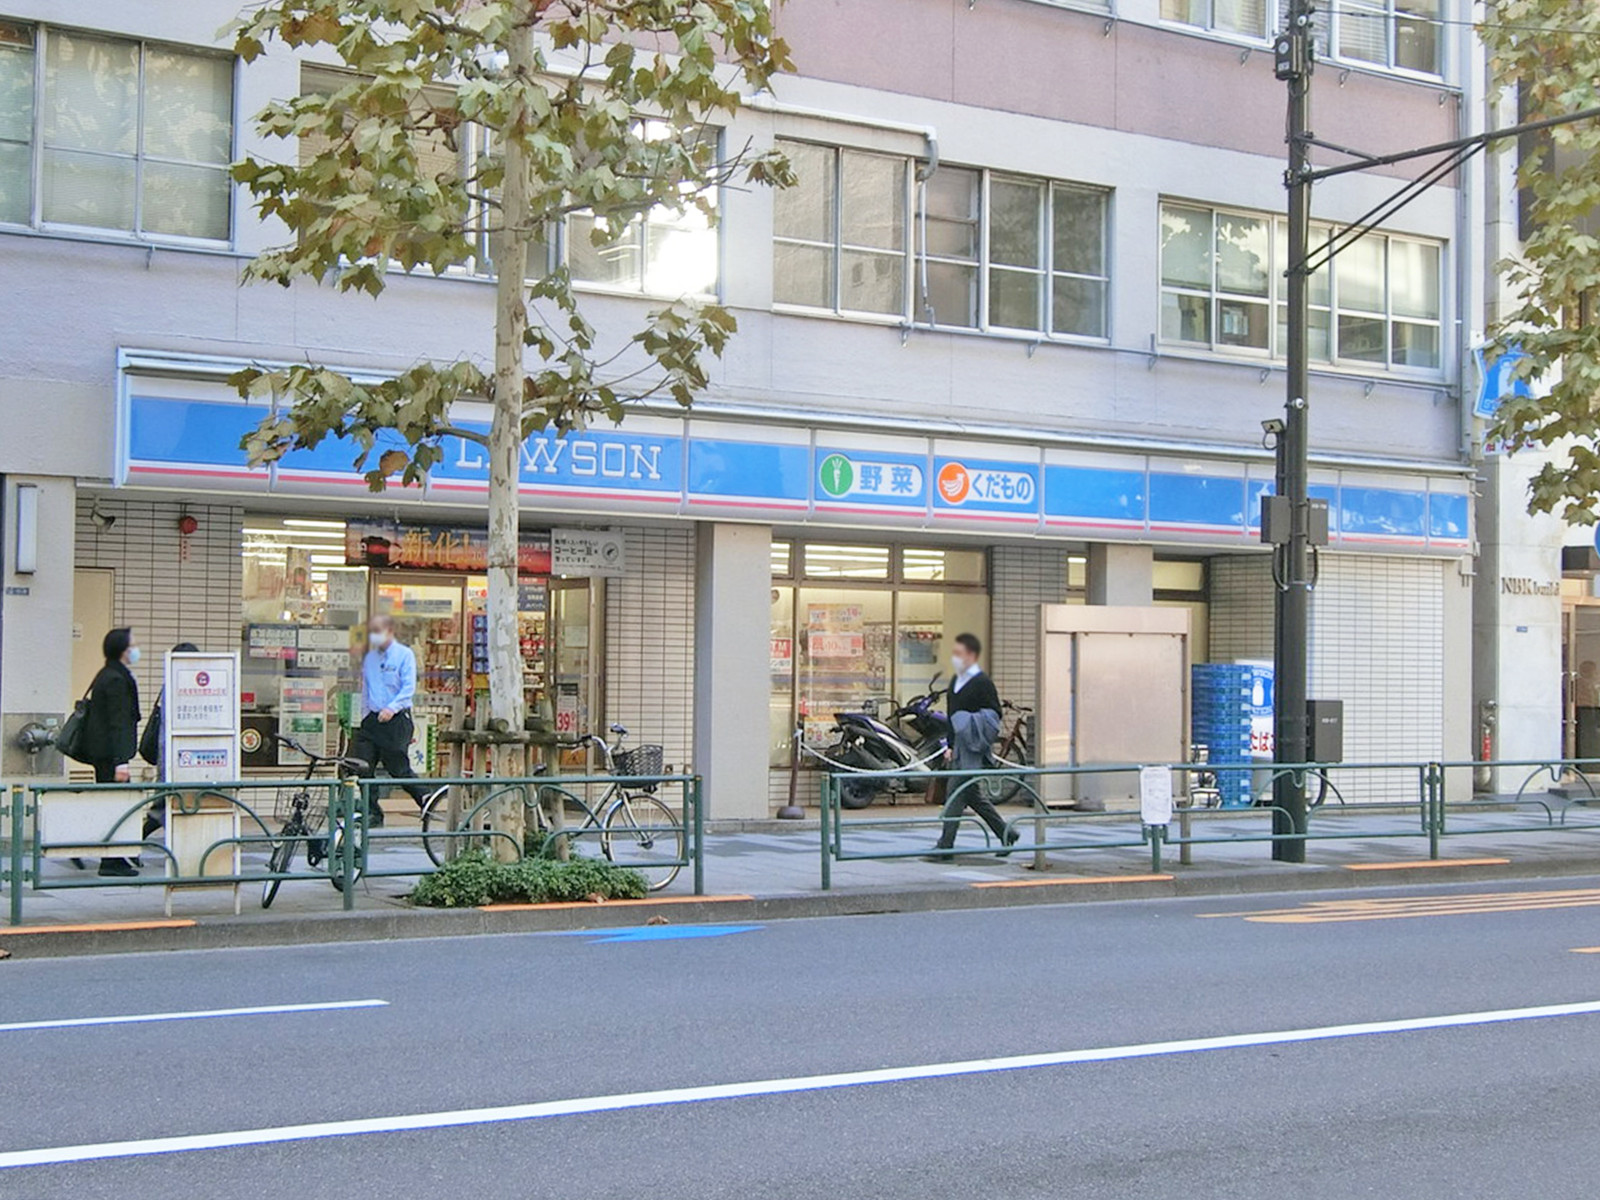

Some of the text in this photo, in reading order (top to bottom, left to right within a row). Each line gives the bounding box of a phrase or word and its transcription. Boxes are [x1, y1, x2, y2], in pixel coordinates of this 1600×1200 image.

[456, 438, 662, 480] LWSON
[860, 464, 914, 494] 野菜
[971, 473, 1031, 500] くだもの
[555, 546, 598, 556] コーヒー豆
[1501, 577, 1532, 595] NBK
